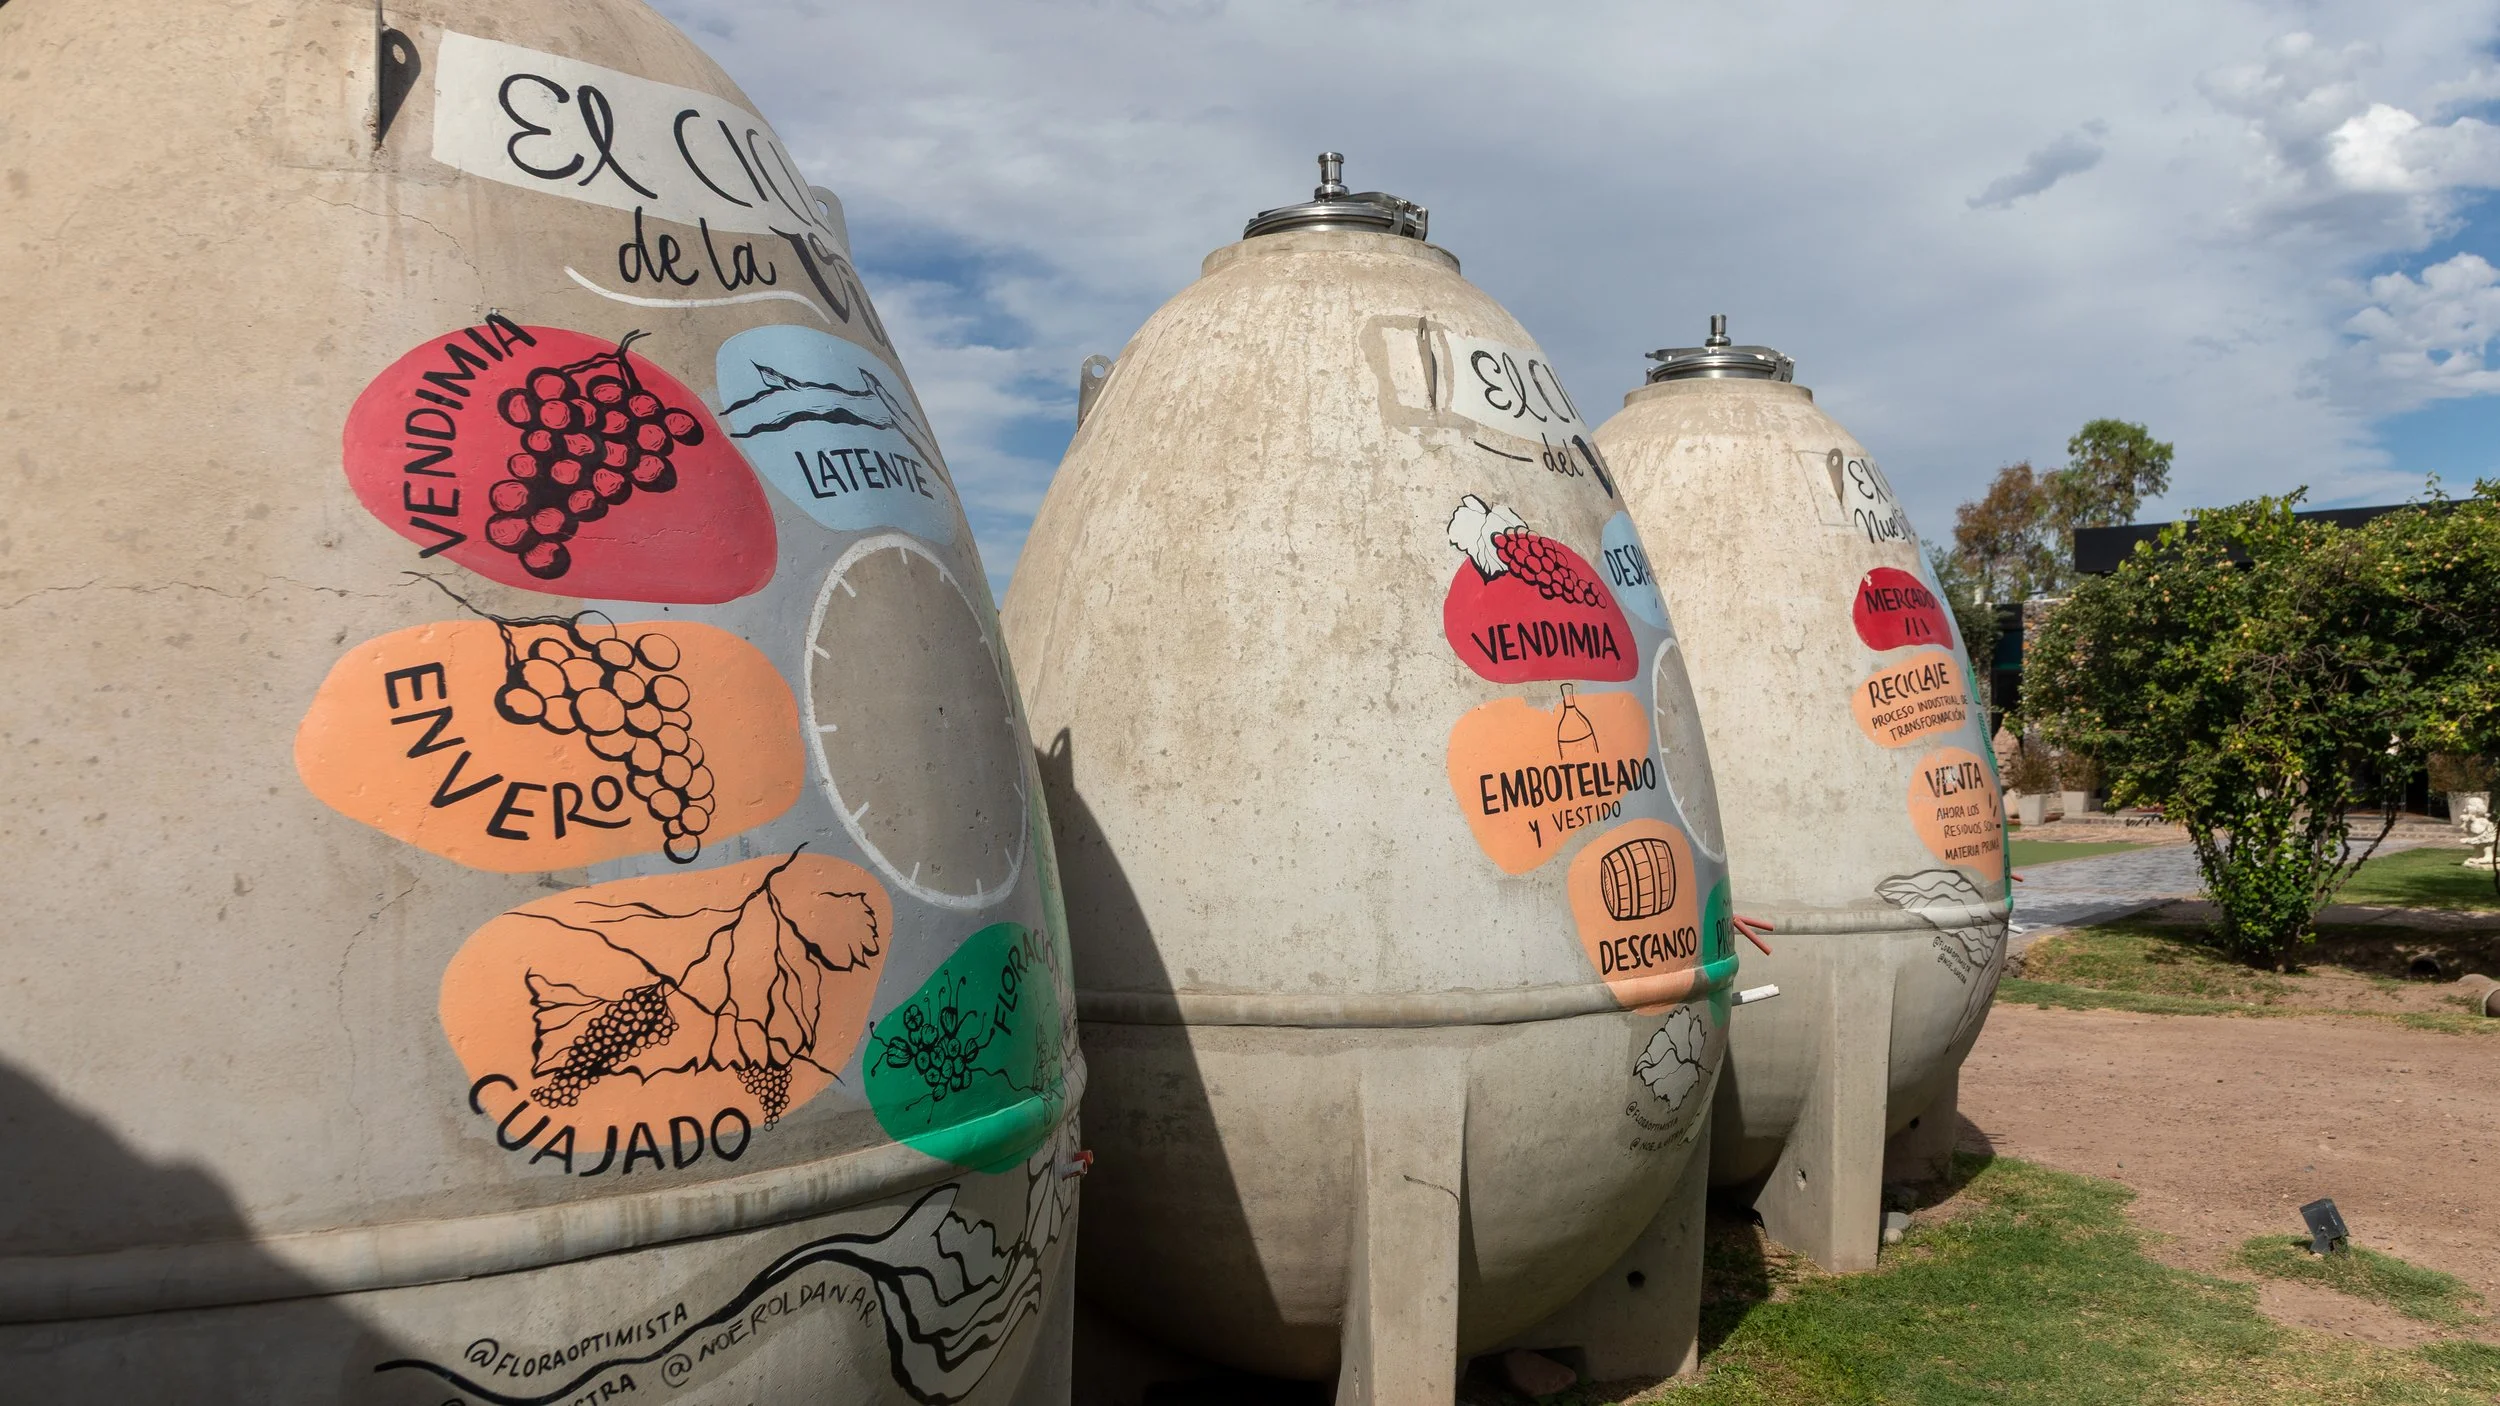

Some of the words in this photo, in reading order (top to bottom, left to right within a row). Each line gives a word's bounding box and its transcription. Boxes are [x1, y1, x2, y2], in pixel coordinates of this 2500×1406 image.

[499, 73, 657, 199] El
[619, 206, 699, 286] de
[699, 217, 776, 291] la
[1470, 350, 1547, 422] El
[404, 313, 538, 558] VENDIMIA
[1543, 432, 1584, 477] del
[796, 449, 934, 500] LATENTE
[1864, 587, 1936, 615] MERCADO
[1471, 620, 1622, 664] VENDIMIA
[1868, 662, 1950, 708] RECICLAJE
[1872, 705, 1915, 729] PROCESO
[1917, 695, 1960, 712] INDUSTRIAL
[385, 662, 631, 840] ENVERO
[1480, 757, 1657, 816] EMBOTELLADO
[1925, 762, 1984, 798] VENTA
[1552, 801, 1622, 832] VESTIDO
[1936, 805, 1966, 821] AHORA
[1967, 803, 1980, 817] LOS
[1944, 822, 1982, 838] RESIDUOS
[1945, 844, 1980, 860] MATERIA
[1599, 926, 1698, 976] DESCANSO
[469, 1074, 752, 1177] CUAJADO
[464, 1302, 689, 1377] @FLORAOPTIMISTA
